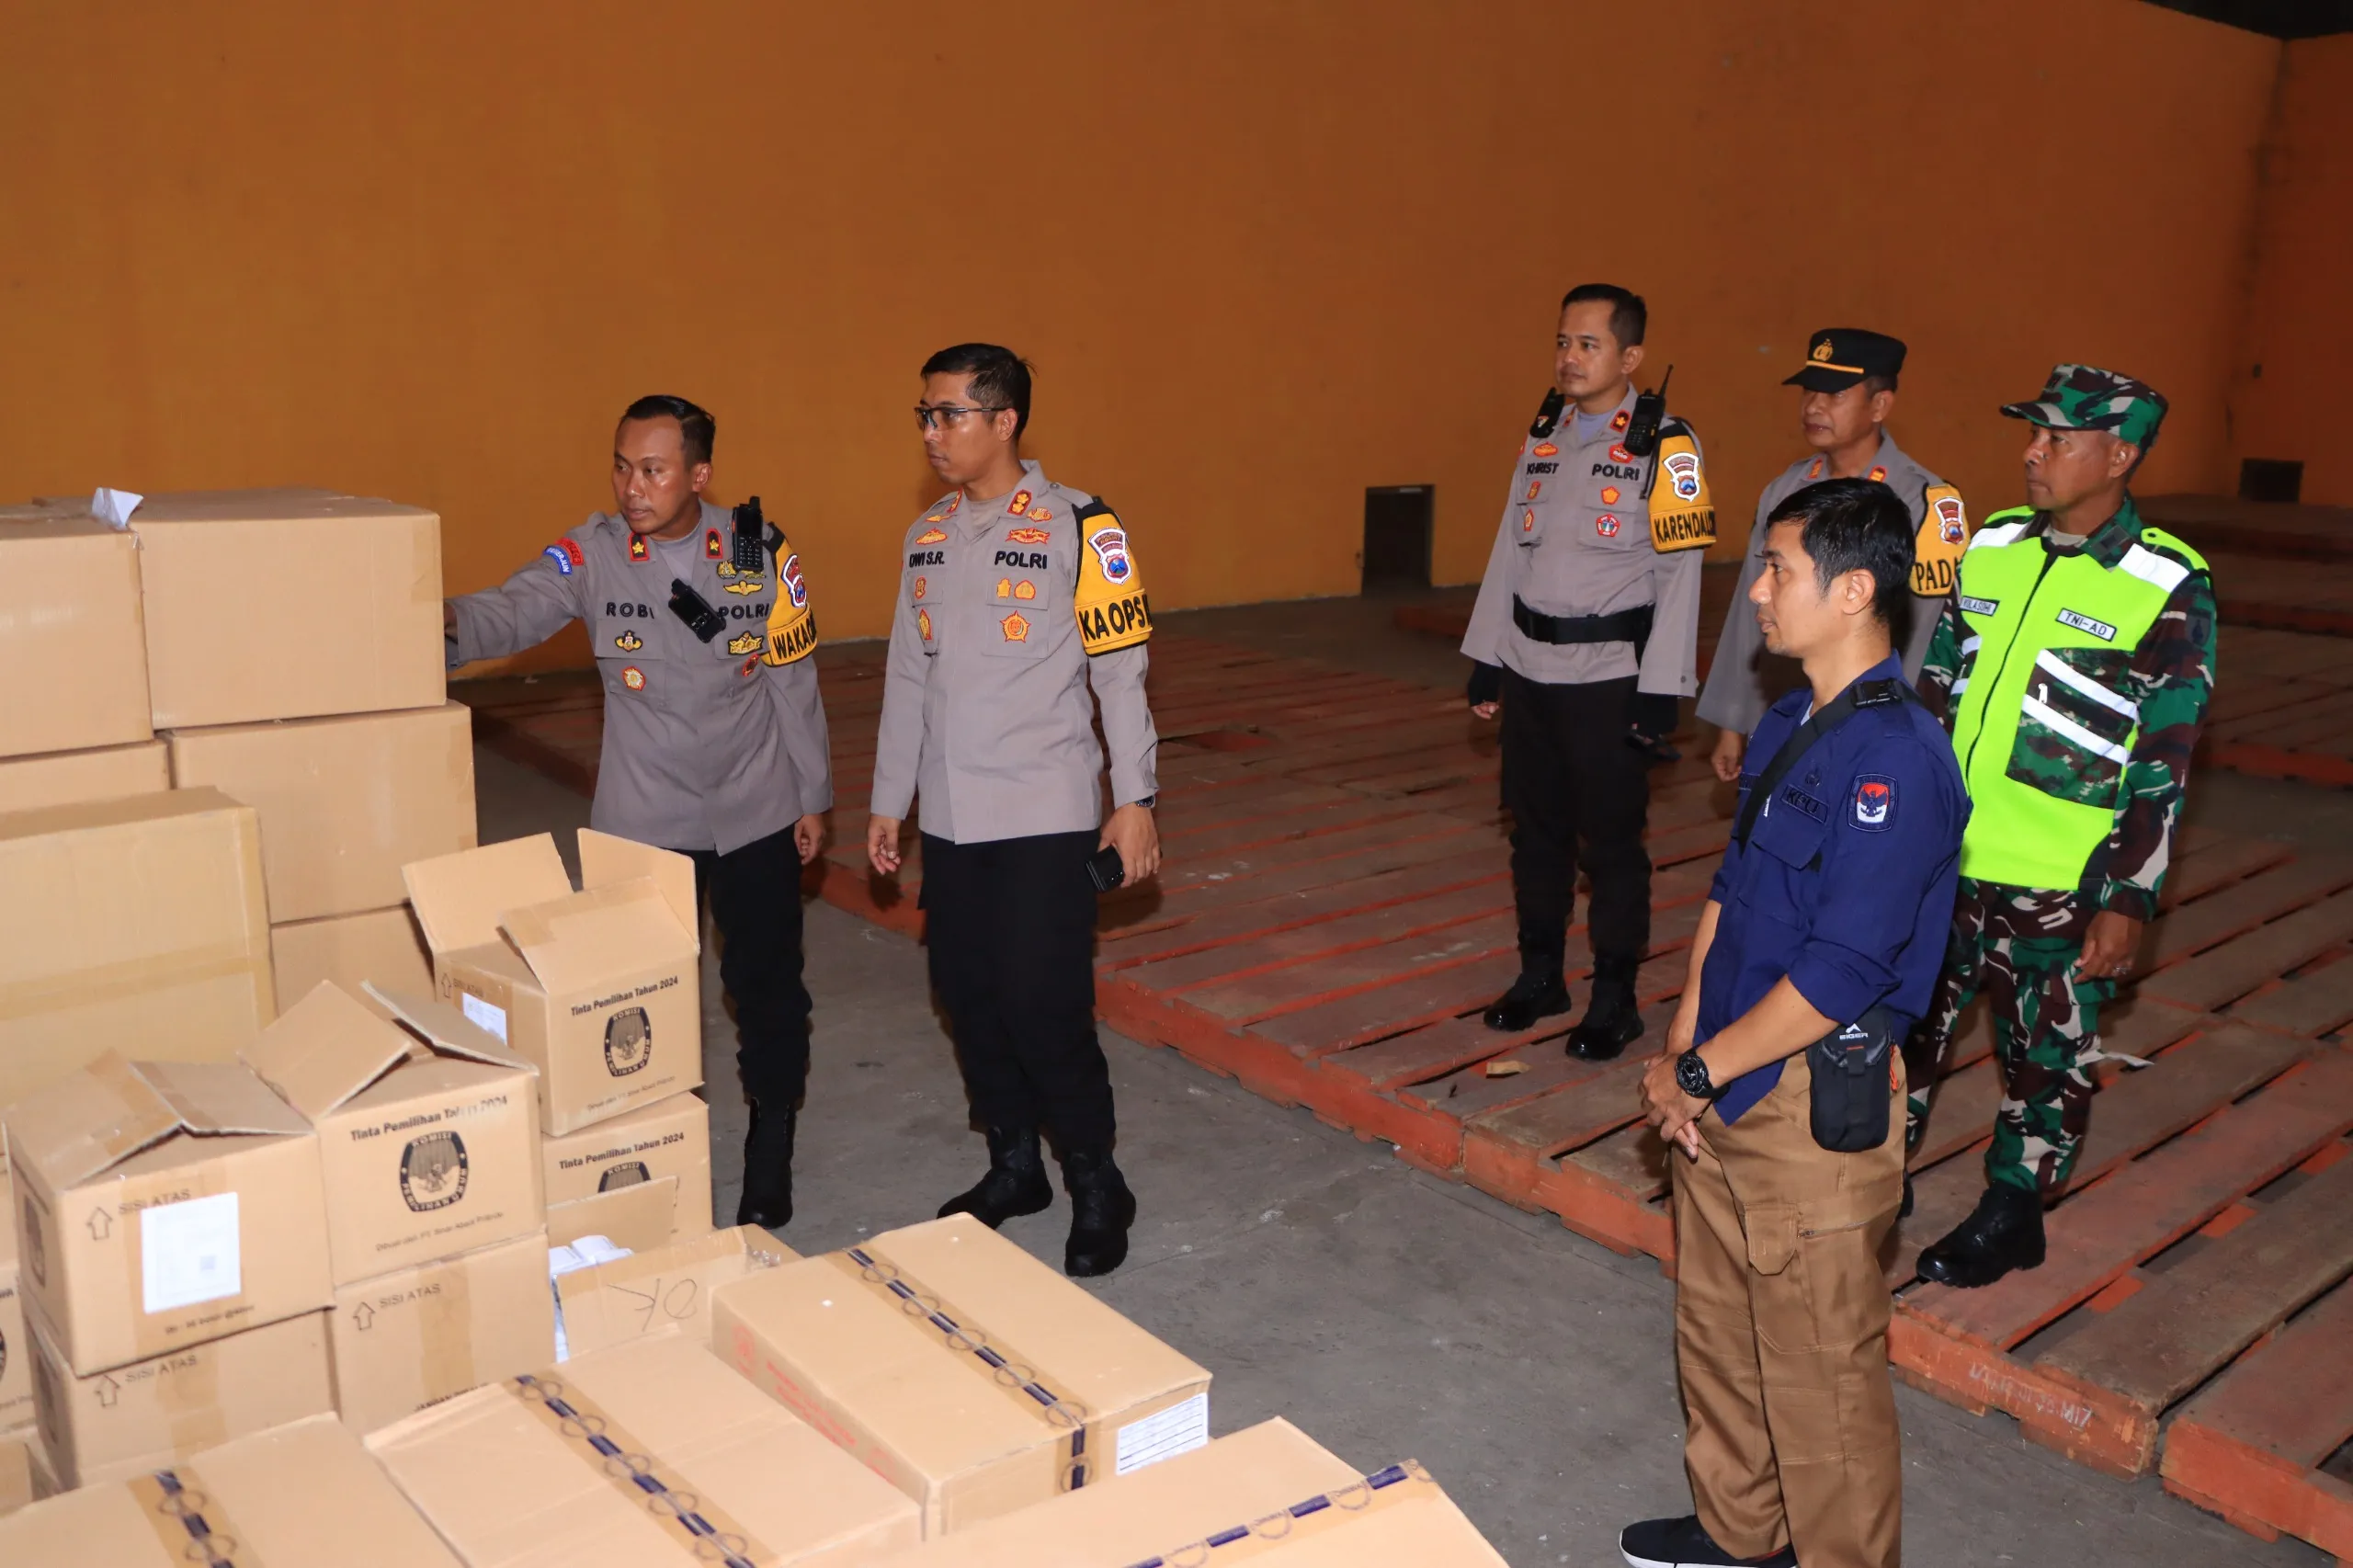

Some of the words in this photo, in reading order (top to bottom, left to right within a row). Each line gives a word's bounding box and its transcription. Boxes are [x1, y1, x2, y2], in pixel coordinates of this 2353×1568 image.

[1526, 462, 1560, 475] KHRIST
[1591, 463, 1640, 481] POLRI
[994, 551, 1048, 570] POLRI
[606, 601, 654, 619] ROBI
[717, 603, 770, 619] POLRI
[2064, 611, 2108, 637] TNI-AD
[1786, 789, 1820, 814] KPU
[571, 1003, 593, 1017] Tinta
[593, 991, 633, 1010] Pemilihan
[635, 983, 658, 996] Tahun
[659, 975, 678, 989] 2024
[1839, 1032, 1869, 1040] EIGER
[350, 1128, 381, 1142] Tinta
[383, 1112, 441, 1133] Pemilihan
[559, 1158, 584, 1170] Tinta
[585, 1146, 632, 1164] Pemilihan
[633, 1140, 660, 1153] Tahun
[662, 1131, 685, 1145] 2024
[379, 1295, 404, 1309] SISI
[407, 1283, 441, 1301] ATAS
[125, 1367, 154, 1383] SISI
[159, 1355, 197, 1375] ATAS
